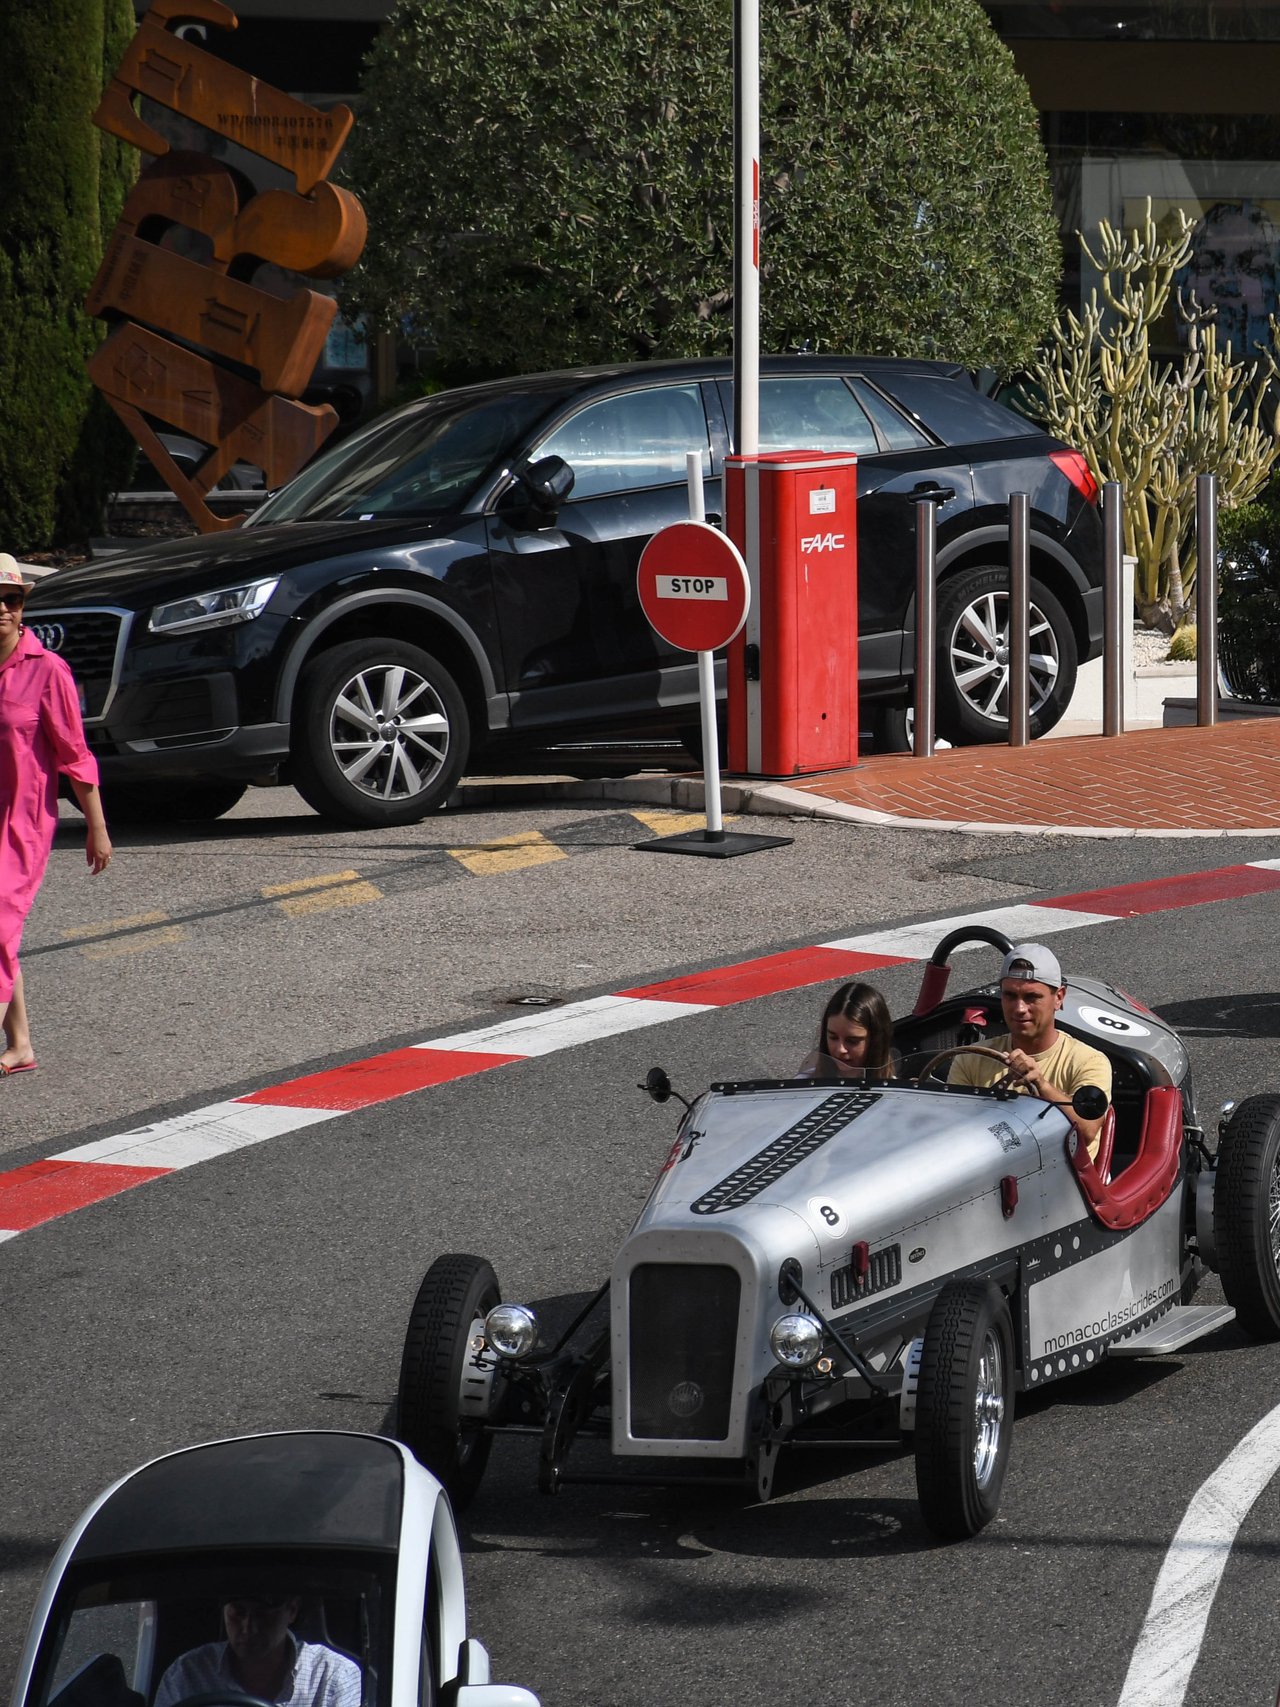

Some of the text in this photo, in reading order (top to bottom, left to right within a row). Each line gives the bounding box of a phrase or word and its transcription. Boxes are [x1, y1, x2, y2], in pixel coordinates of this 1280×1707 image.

[801, 533, 845, 553] FAAC
[671, 578, 715, 594] STOP
[1098, 1016, 1131, 1031] 8
[820, 1205, 840, 1226] 8
[1044, 1278, 1174, 1354] monacoclassicrides.com
